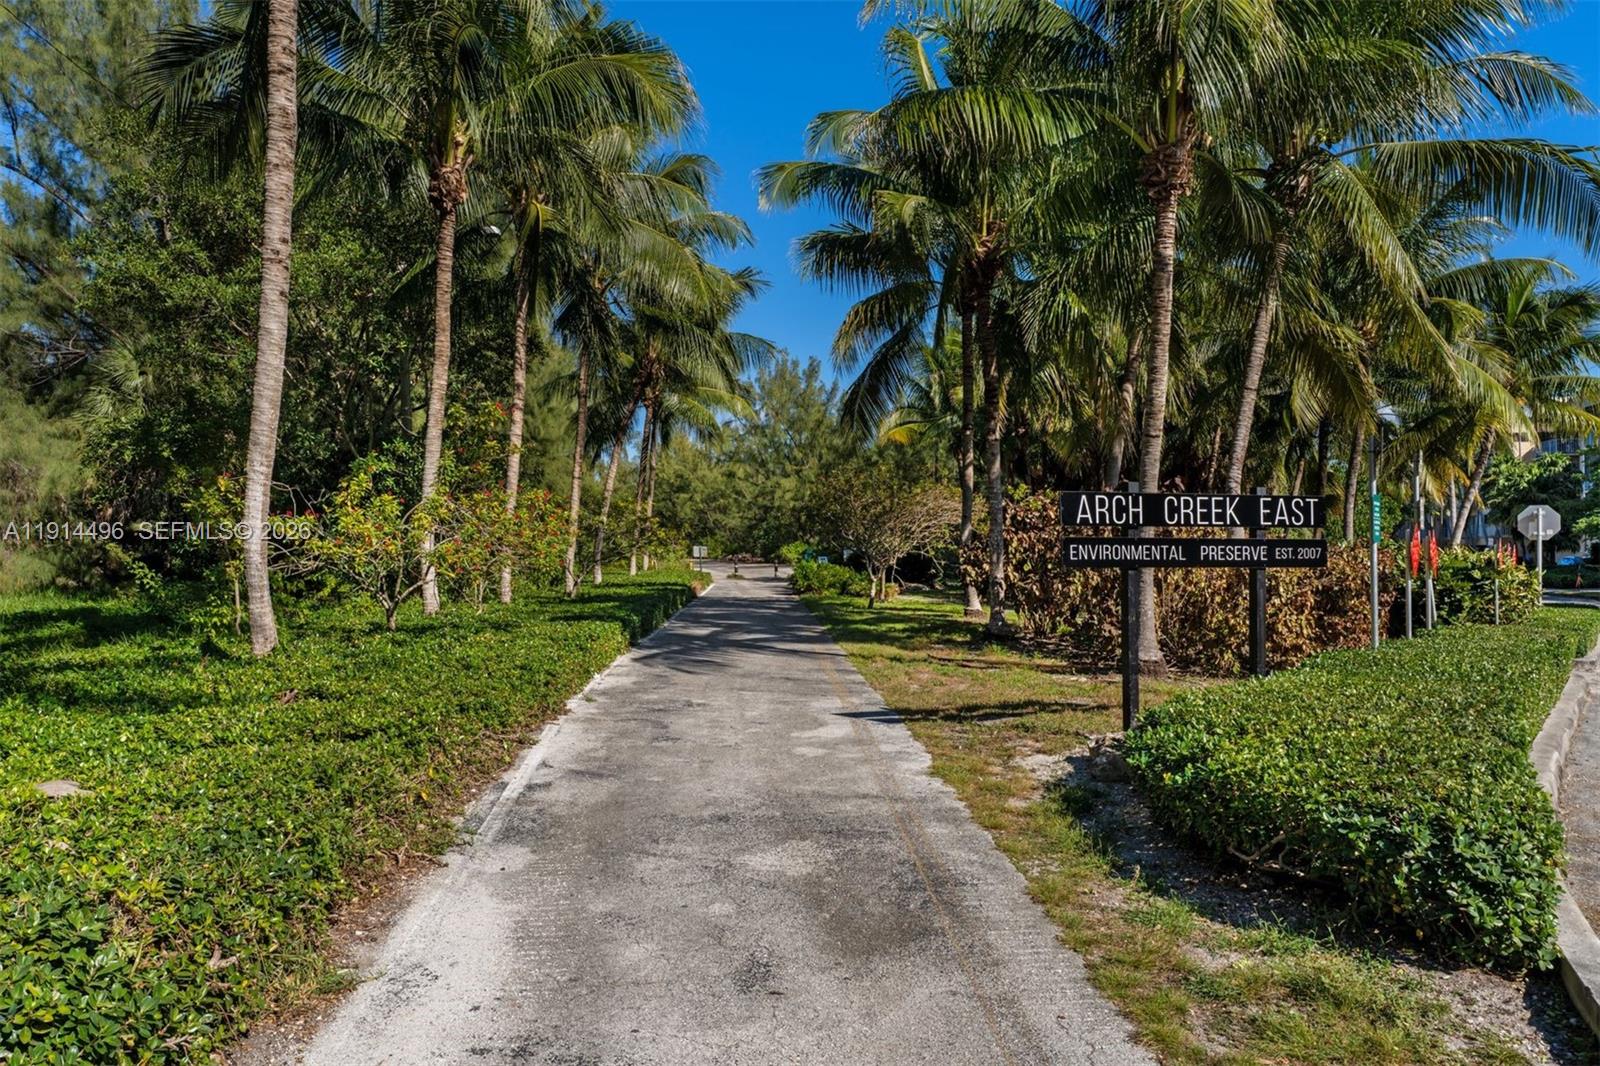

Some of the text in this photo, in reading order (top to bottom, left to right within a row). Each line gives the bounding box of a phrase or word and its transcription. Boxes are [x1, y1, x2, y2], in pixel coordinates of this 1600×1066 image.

[1076, 494, 1319, 526] ARCH CREEK EAST
[1069, 544, 1322, 561] ENVIRONMENTAL PRESERVE EST. 2007
